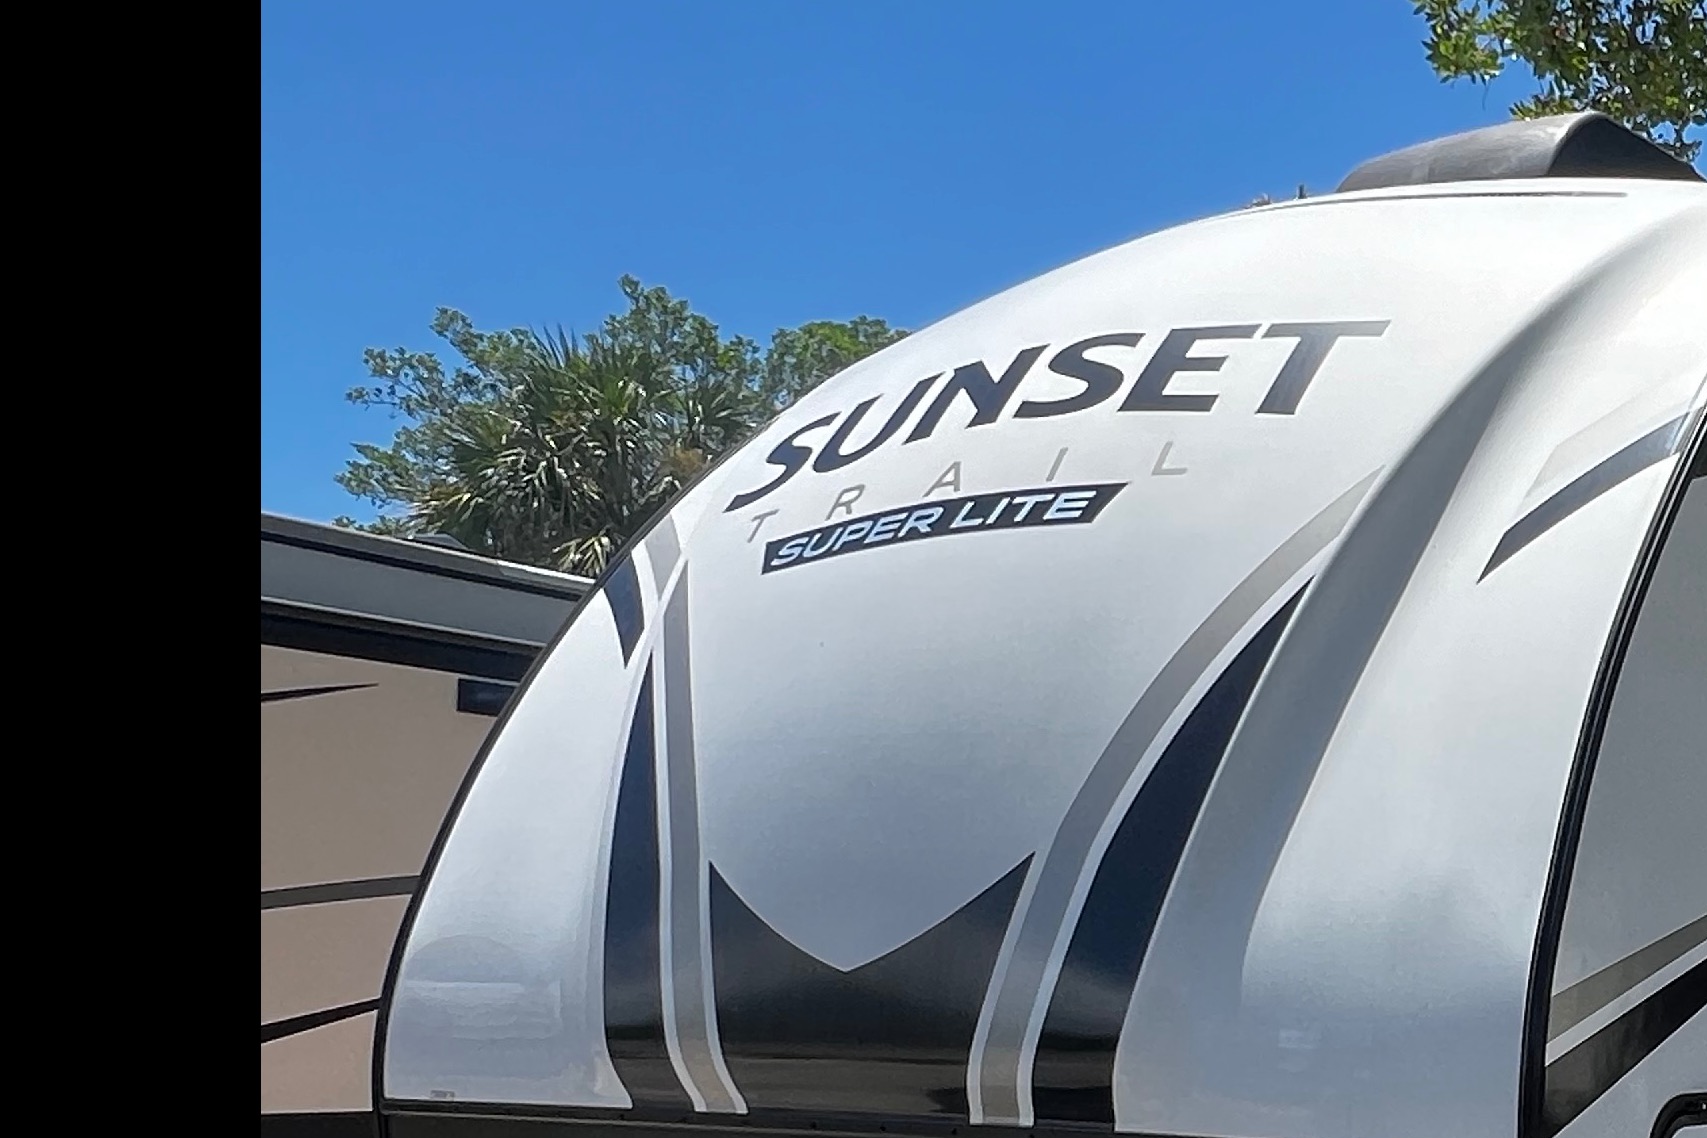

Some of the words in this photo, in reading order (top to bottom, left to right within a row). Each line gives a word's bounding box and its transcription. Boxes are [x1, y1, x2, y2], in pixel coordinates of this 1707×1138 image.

[723, 320, 1390, 512] SUNSET
[747, 441, 1187, 543] TRAIL
[770, 506, 945, 566] SUPER
[950, 490, 1098, 529] LITE
